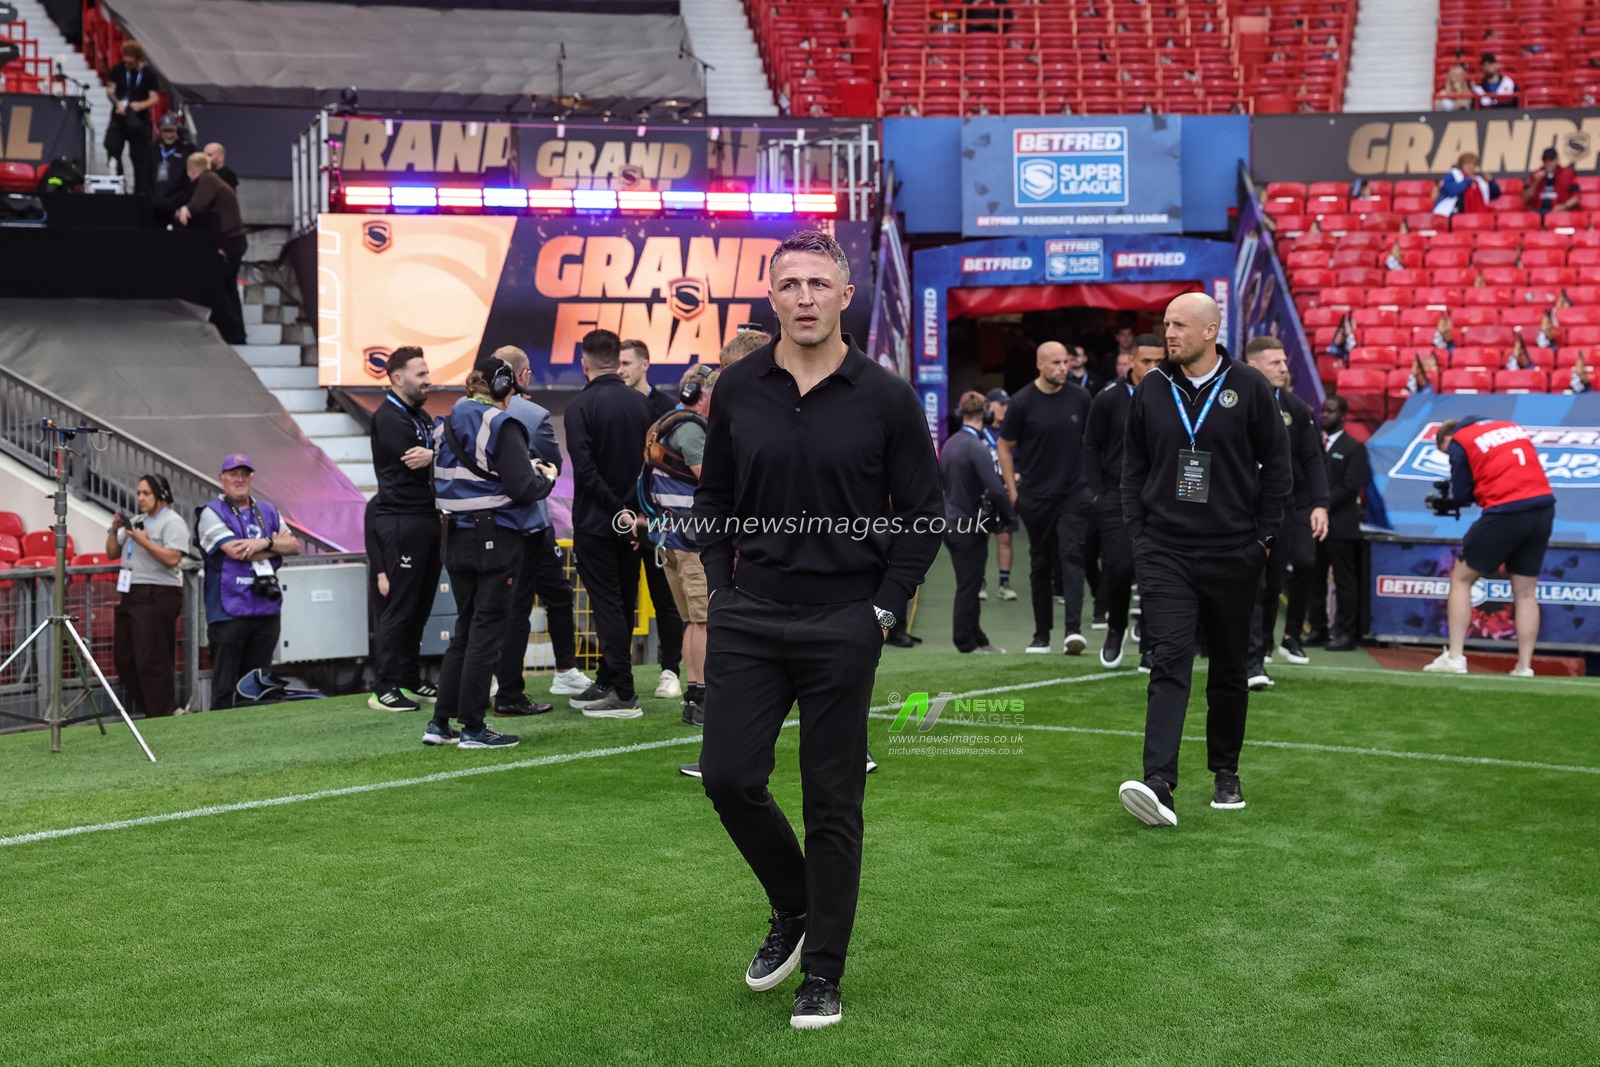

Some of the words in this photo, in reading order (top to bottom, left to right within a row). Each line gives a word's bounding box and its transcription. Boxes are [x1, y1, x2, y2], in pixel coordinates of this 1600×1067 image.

[1020, 133, 1122, 151] BETFRED
[1347, 119, 1579, 175] GRAND
[535, 140, 692, 179] GRAND
[1059, 163, 1122, 180] SUPER
[1059, 180, 1122, 194] LEAGUE
[1023, 215, 1074, 225] PASSIONATE
[1076, 214, 1104, 224] ABOUT
[1106, 213, 1134, 224] SUPER
[1135, 213, 1169, 224] LEAGUE
[535, 235, 777, 299] GRAND
[963, 258, 1033, 271] BETFRED
[1116, 252, 1186, 267] BETFRED
[924, 288, 938, 357] BETFRED
[1512, 448, 1526, 466] 7
